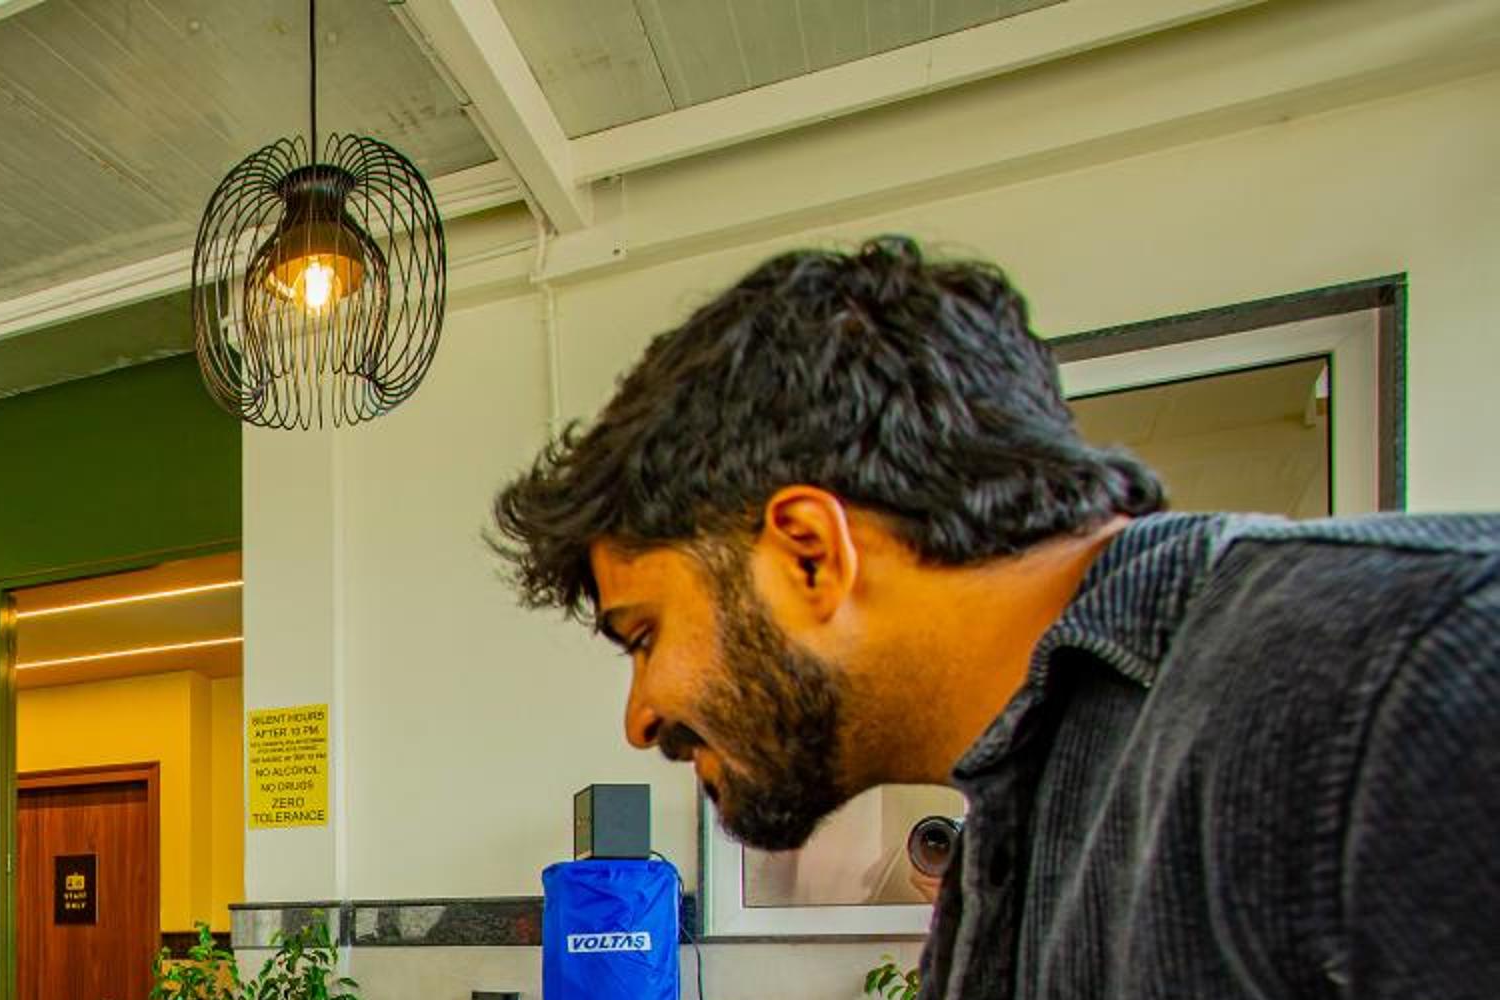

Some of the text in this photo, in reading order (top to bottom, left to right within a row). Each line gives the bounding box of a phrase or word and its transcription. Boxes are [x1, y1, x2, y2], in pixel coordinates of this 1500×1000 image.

[287, 711, 325, 723] HOURS
[255, 727, 287, 738] AFTER
[303, 725, 320, 736] PM
[255, 765, 319, 777] NO ALCOHOL
[260, 780, 314, 792] NO DRUGS
[271, 797, 305, 809] ZERO
[251, 810, 325, 823] TOLERANCE
[572, 935, 646, 951] VOLTAS
